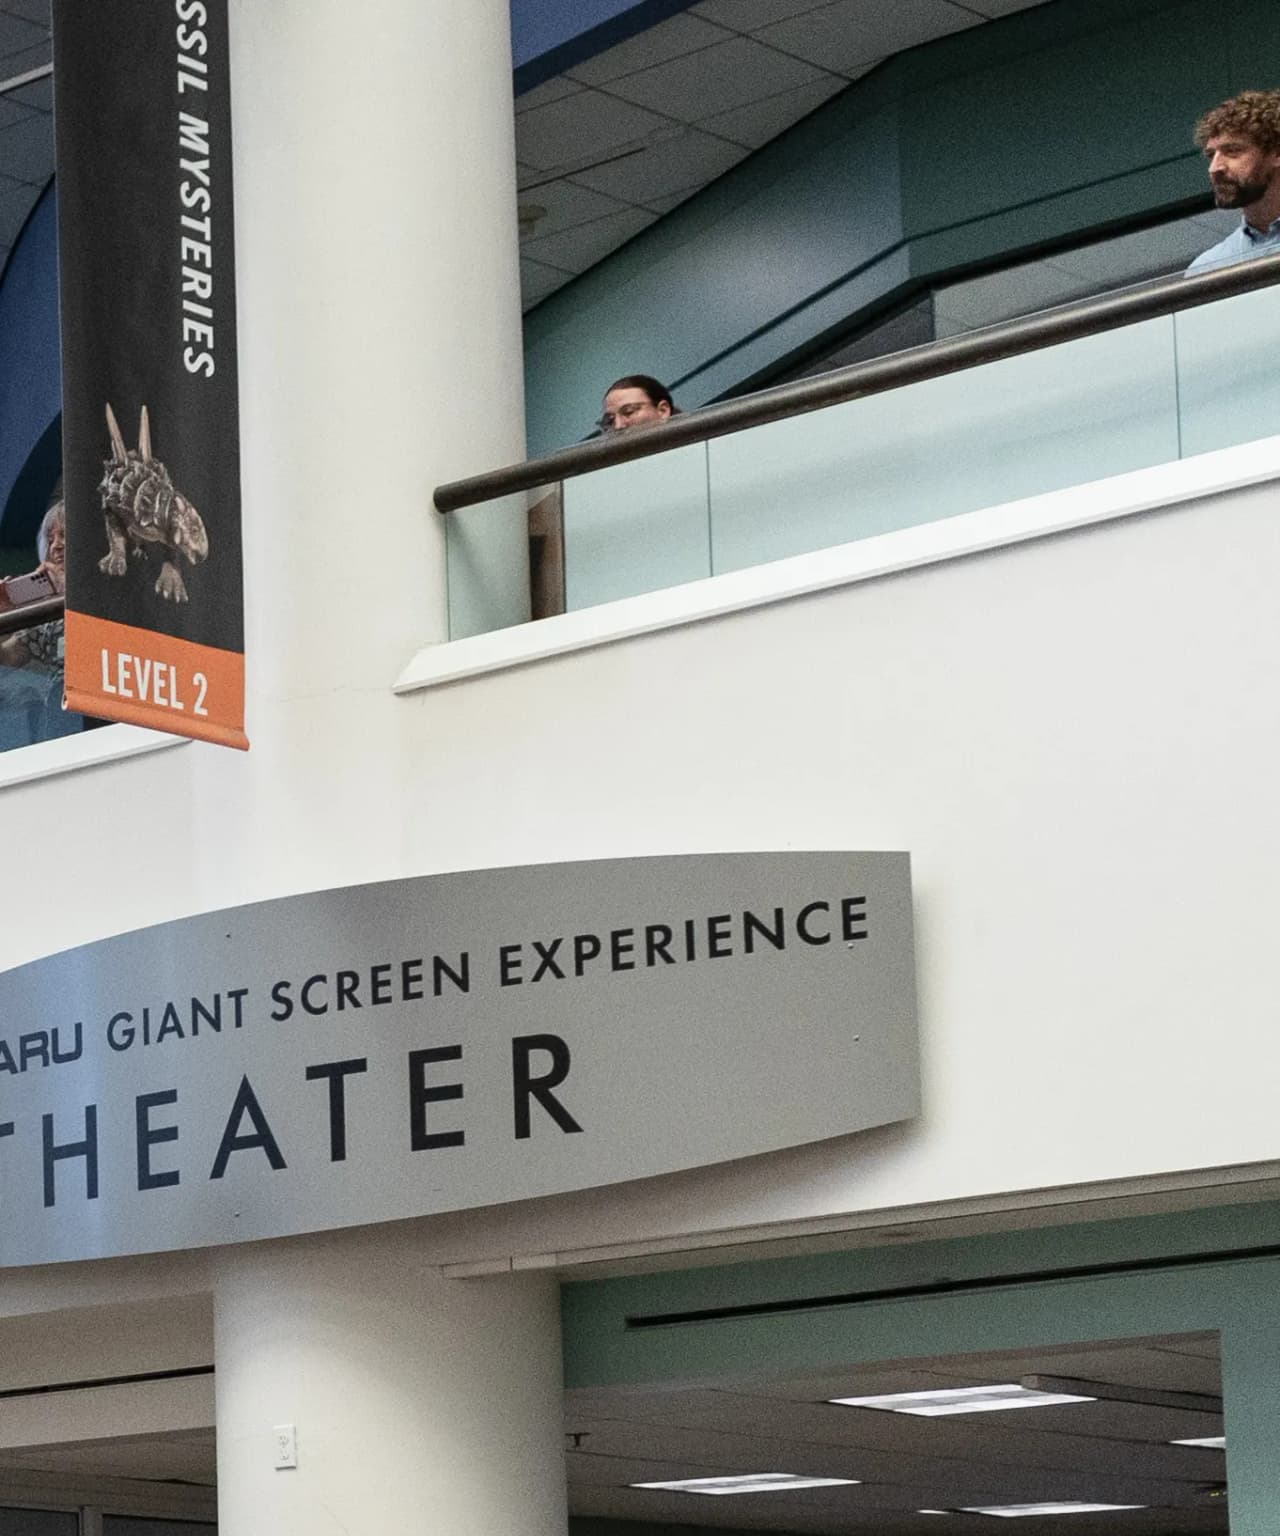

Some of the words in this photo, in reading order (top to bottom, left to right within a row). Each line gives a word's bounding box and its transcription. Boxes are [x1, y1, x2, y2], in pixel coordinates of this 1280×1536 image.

[179, 111, 215, 378] MYSTERIES
[101, 648, 185, 711] LEVEL
[192, 671, 209, 716] 2
[106, 988, 249, 1052] GIANT
[270, 951, 470, 1022] SCREEN
[499, 896, 869, 986] EXPERIENCE
